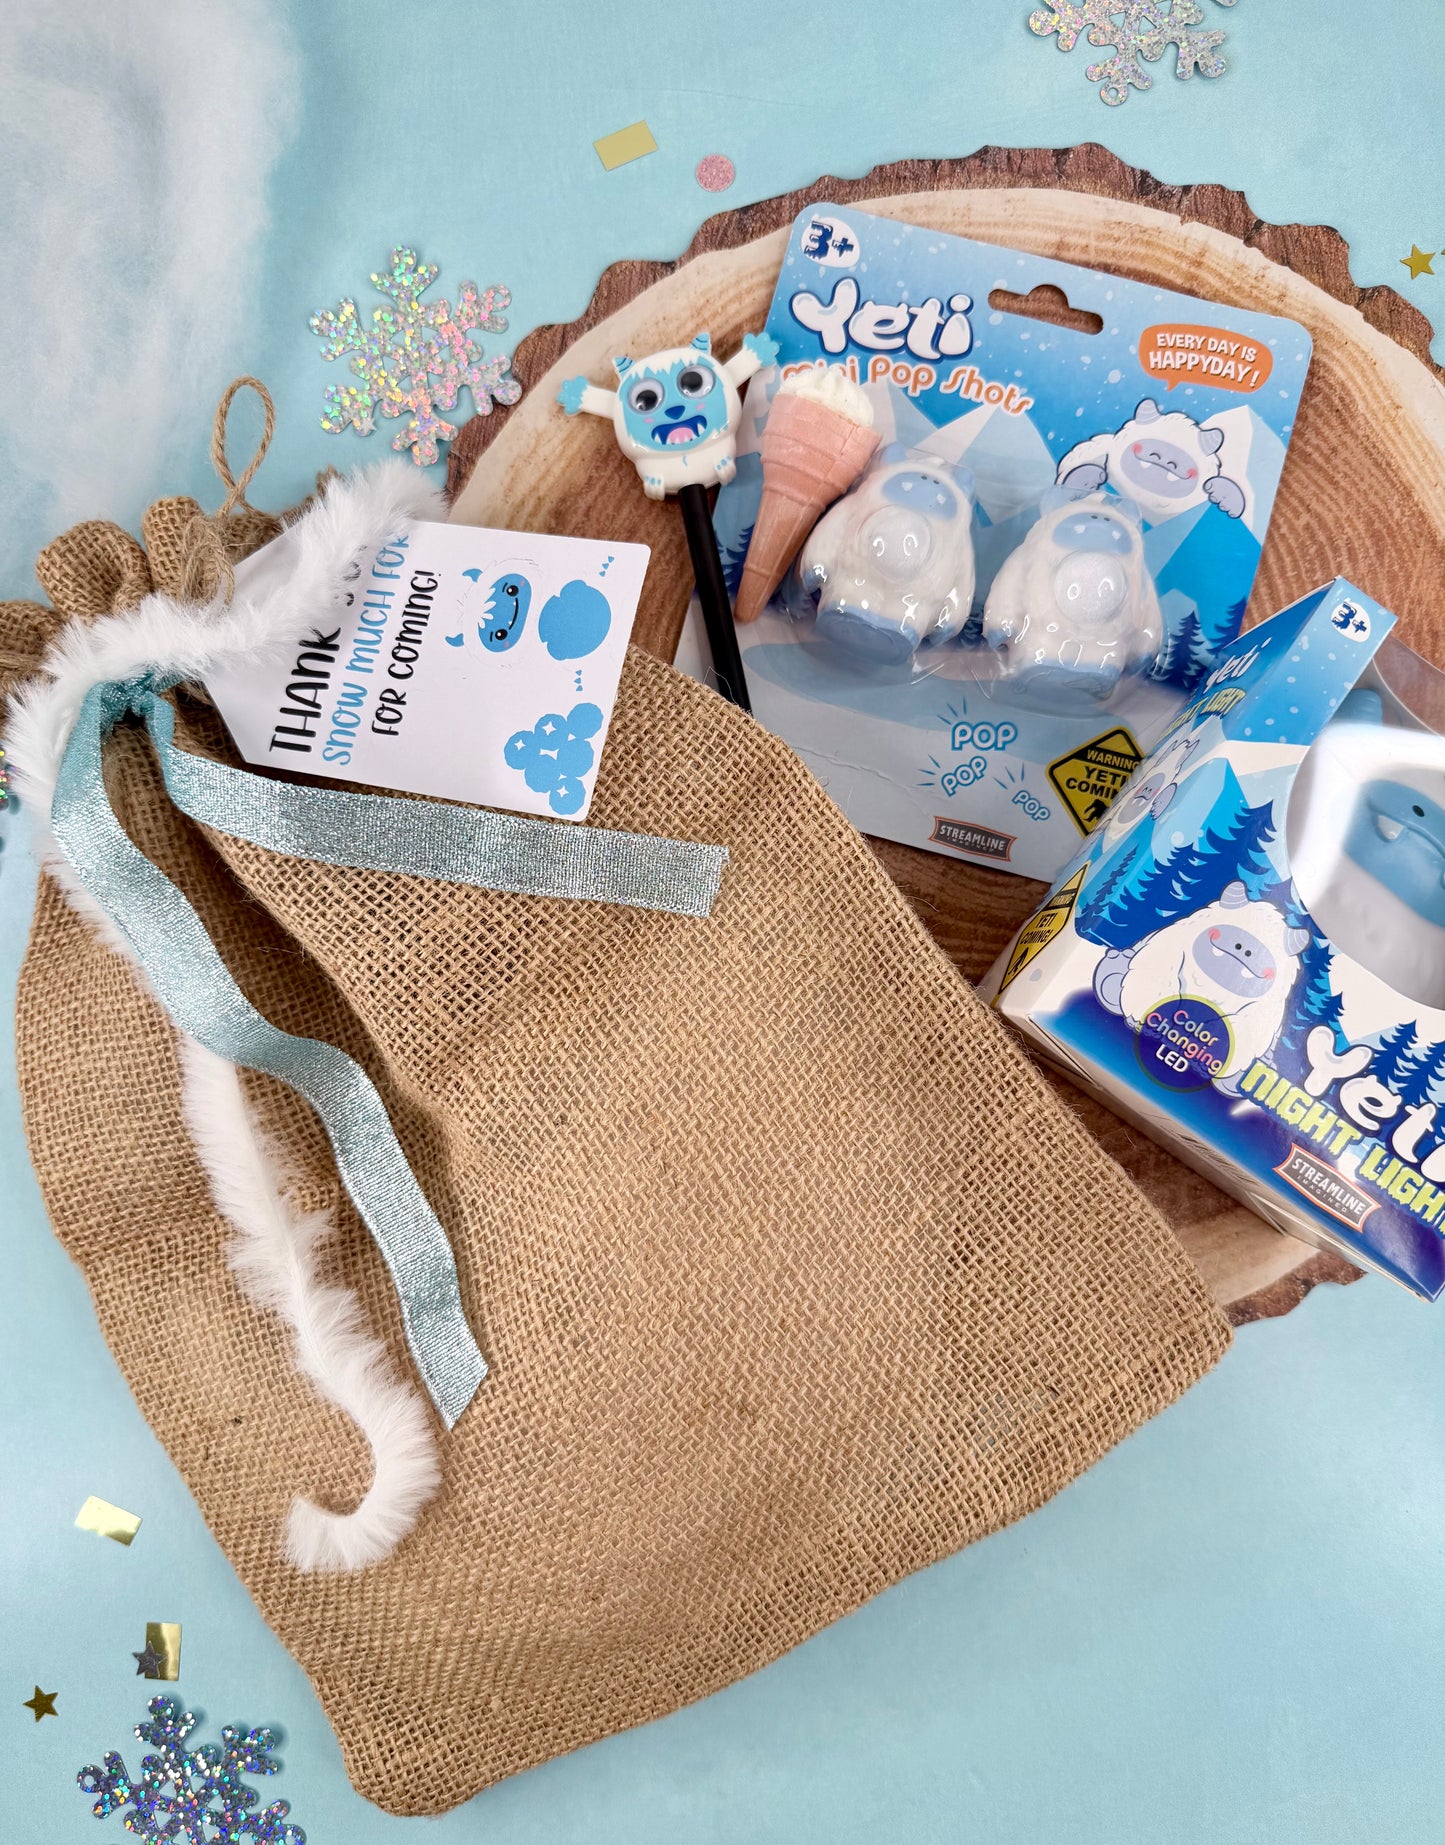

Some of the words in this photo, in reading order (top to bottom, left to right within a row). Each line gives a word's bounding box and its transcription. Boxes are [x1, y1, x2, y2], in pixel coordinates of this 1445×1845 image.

[803, 220, 855, 260] 3+
[789, 277, 974, 363] Yeti
[1156, 333, 1206, 350] EVERY
[1207, 337, 1240, 357] DAY
[1240, 345, 1257, 363] IS
[871, 357, 935, 395] Pop
[942, 367, 1032, 416] Shots
[1331, 602, 1367, 633] 3+
[371, 688, 407, 736] FOR
[952, 721, 1018, 751] POP
[941, 756, 987, 797] POP
[1012, 790, 1050, 821] POP
[939, 825, 1006, 851] STREAMLINE
[1146, 1012, 1223, 1076] Changing
[1173, 1009, 1219, 1047] Color
[1155, 1044, 1189, 1073] LED
[1239, 1058, 1362, 1157] NIGHT
[1358, 1144, 1445, 1236] LIGH
[1291, 1157, 1367, 1216] STREAMLINE
[1296, 1174, 1348, 1214] IMAGINED
